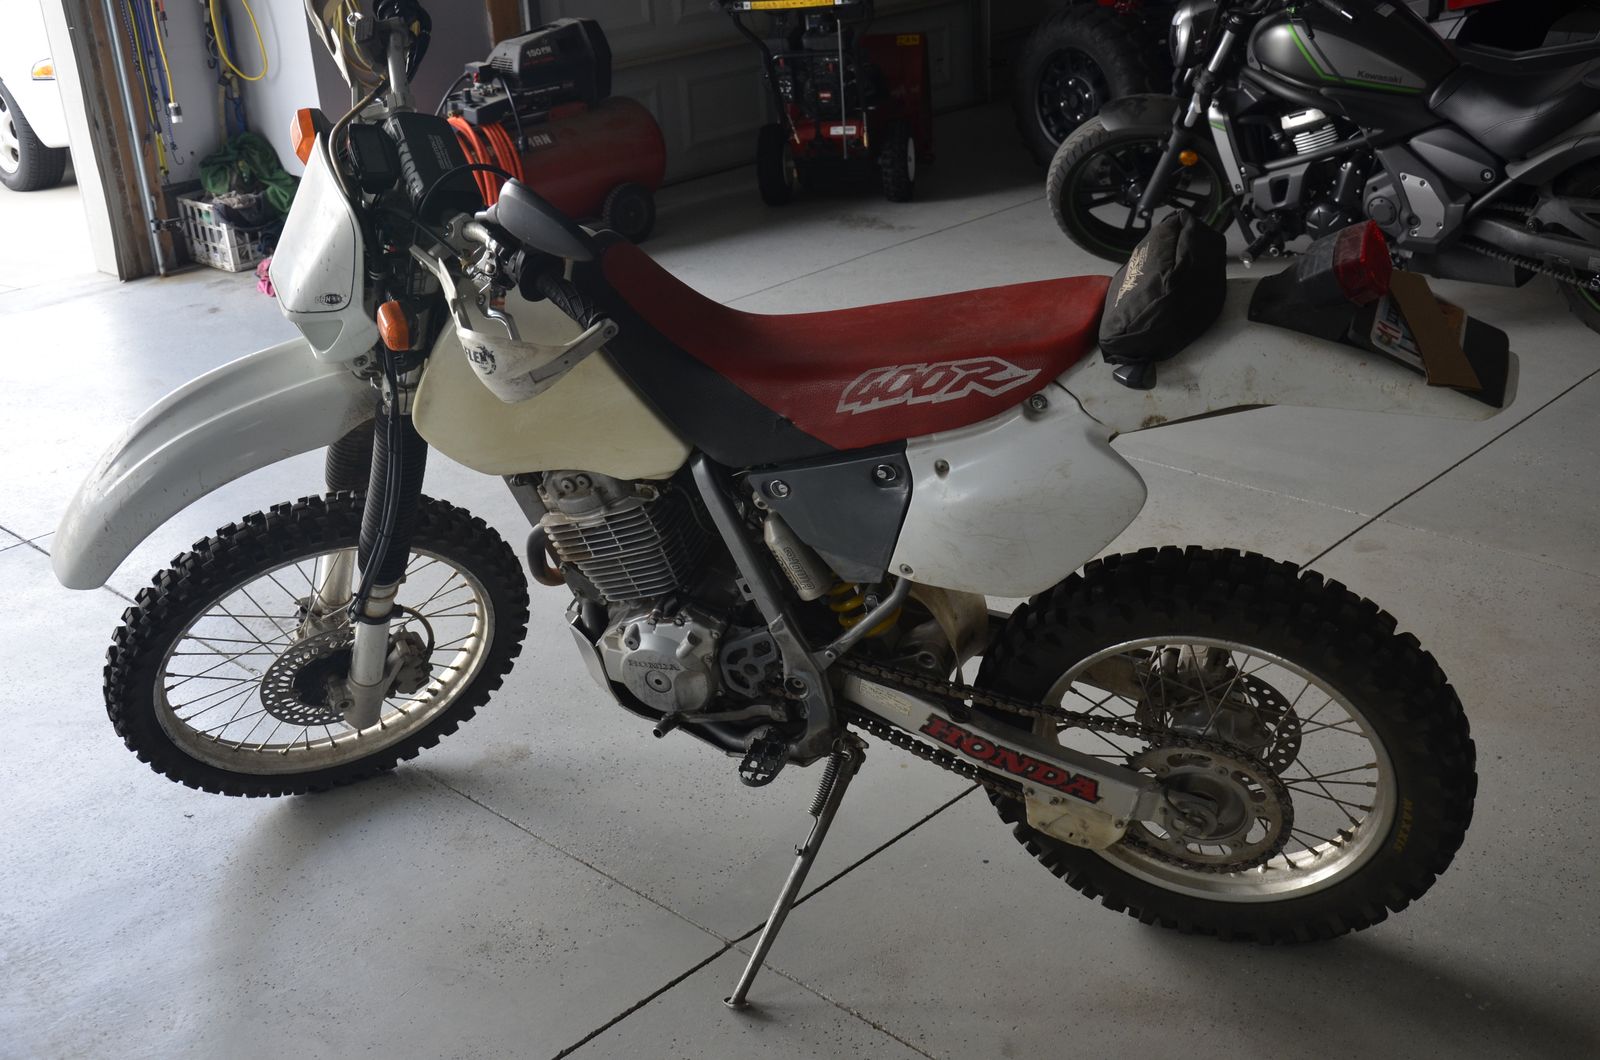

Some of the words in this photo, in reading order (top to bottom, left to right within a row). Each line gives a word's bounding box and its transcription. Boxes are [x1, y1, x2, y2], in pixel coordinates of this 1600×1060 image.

[1357, 70, 1402, 84] Kawasaki
[628, 659, 681, 671] HONDA
[919, 713, 1103, 804] HONDA
